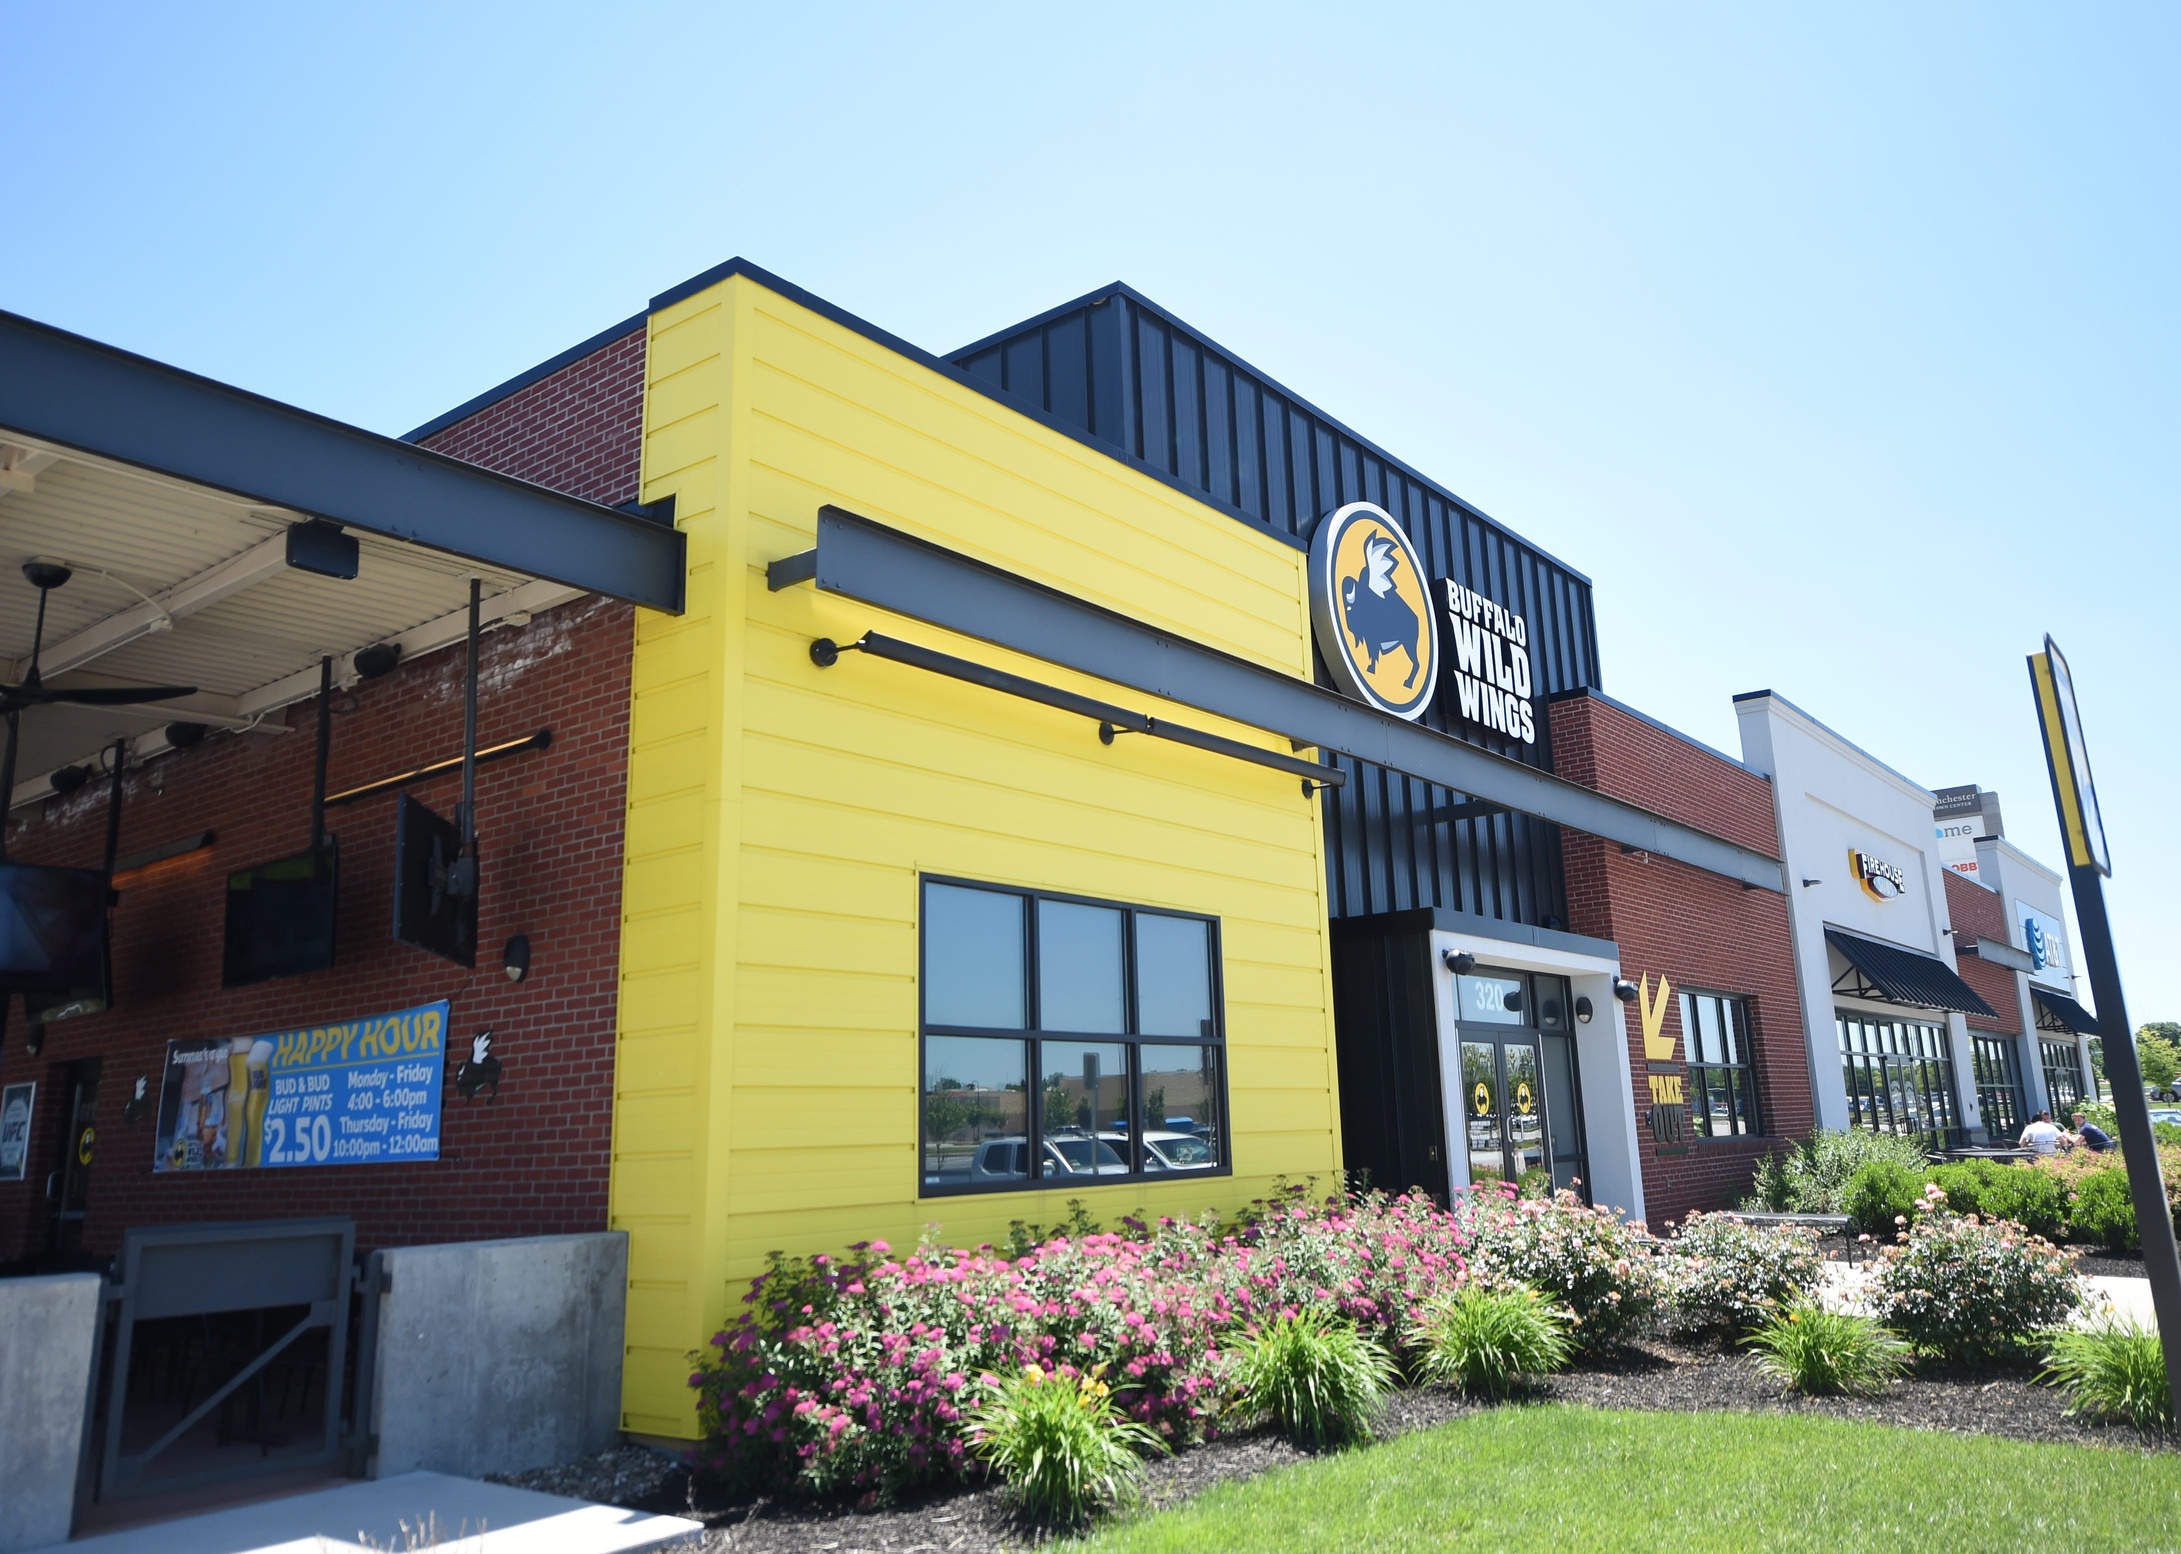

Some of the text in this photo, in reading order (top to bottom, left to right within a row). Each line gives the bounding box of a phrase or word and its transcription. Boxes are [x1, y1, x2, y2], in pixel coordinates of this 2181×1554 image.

[1445, 577, 1527, 647] BUFFALO
[1448, 611, 1531, 700] WILD
[1453, 669, 1536, 745] WINGS
[1936, 793, 1977, 805] nchester
[1949, 801, 1973, 809] CENTER
[1944, 824, 1973, 838] me
[1861, 853, 1905, 893] FIREHOUSE
[1951, 862, 1978, 873] OBB
[1475, 981, 1504, 1012] 320
[272, 1010, 441, 1068] HAPPY HOUR
[275, 1077, 297, 1096] BUD
[297, 1076, 306, 1093] &
[307, 1073, 330, 1093] BUD
[347, 1068, 389, 1090] Monday
[396, 1063, 433, 1085] Friday
[1648, 1075, 1684, 1105] TAKE
[268, 1093, 333, 1115] LIGHT PINTS
[347, 1091, 374, 1111] 4:00
[382, 1087, 427, 1110] 6:00pm
[340, 1113, 389, 1136] Thursday
[397, 1110, 433, 1133] Friday
[1652, 1104, 1684, 1144] OUT
[264, 1114, 332, 1163] $2.50
[333, 1137, 380, 1160] 10:00pm
[388, 1134, 439, 1154] 12:00am
